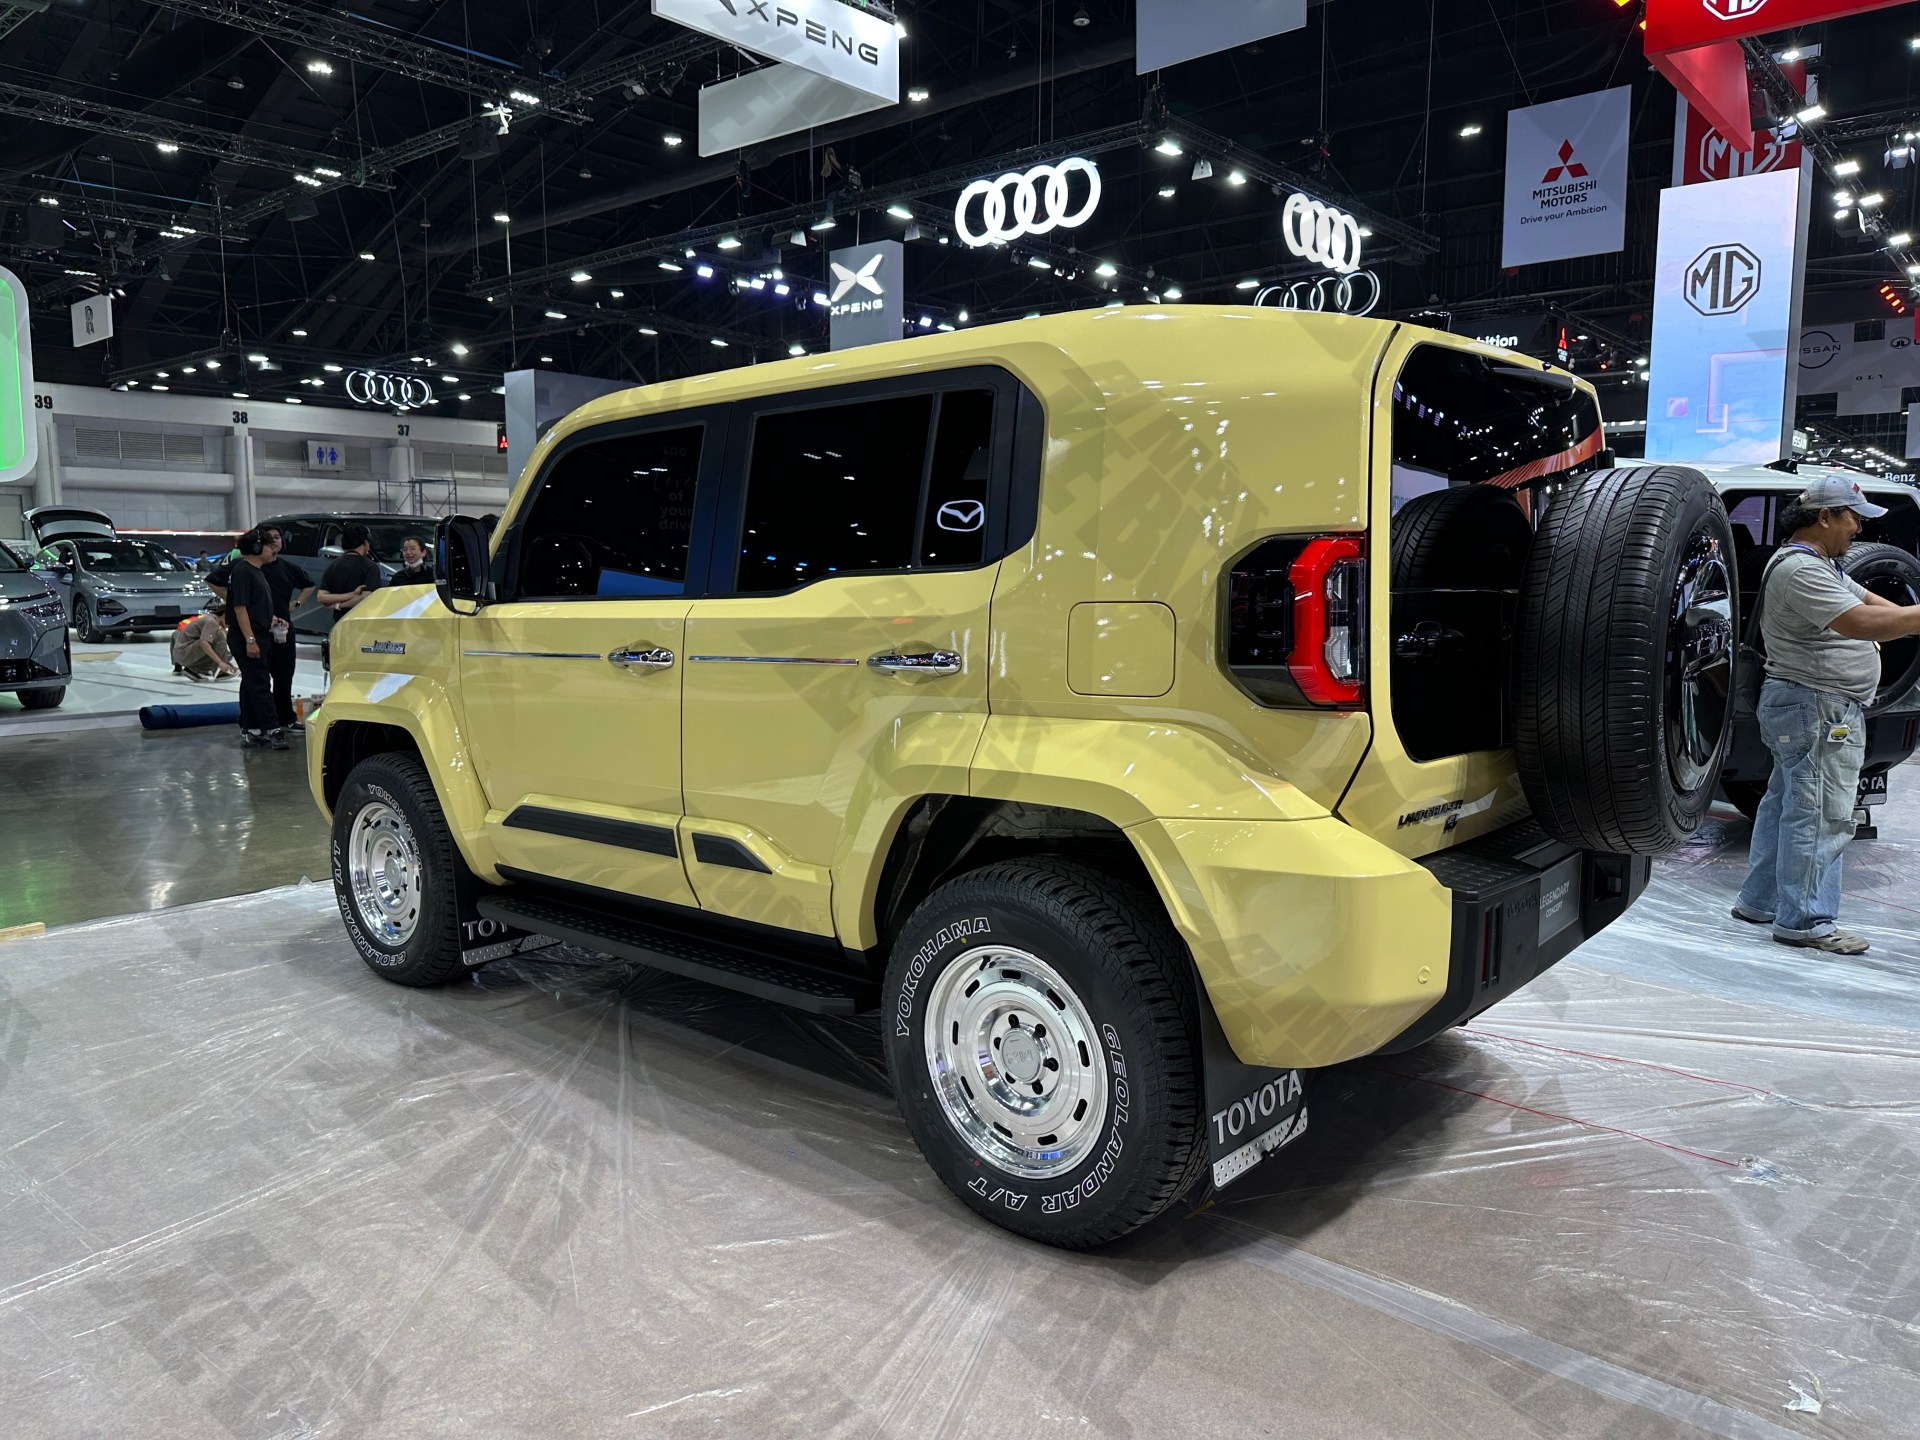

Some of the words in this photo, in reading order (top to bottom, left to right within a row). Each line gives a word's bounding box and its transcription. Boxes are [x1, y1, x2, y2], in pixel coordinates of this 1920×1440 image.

[746, 0, 879, 65] XPENG
[1532, 180, 1597, 200] MITSUBISHI
[1540, 193, 1588, 208] MOTORS
[1520, 215, 1543, 225] Drive
[1544, 211, 1565, 224] your
[1565, 205, 1608, 218] Ambition
[1690, 252, 1754, 309] MG
[831, 298, 883, 315] XPENG
[35, 395, 53, 409] 39
[232, 411, 249, 424] 38
[398, 425, 410, 437] 37
[368, 783, 423, 875] YOKOHAMA
[1540, 881, 1570, 910] LEGENDARY
[1545, 901, 1563, 918] CONCEPT
[339, 895, 407, 966] GEOLANDAR
[896, 916, 991, 1036] YOKOHAMA
[1041, 1022, 1130, 1214] GEOLANDAR
[1212, 1069, 1303, 1145] TOYOTA
[967, 1177, 1028, 1211] A/T
